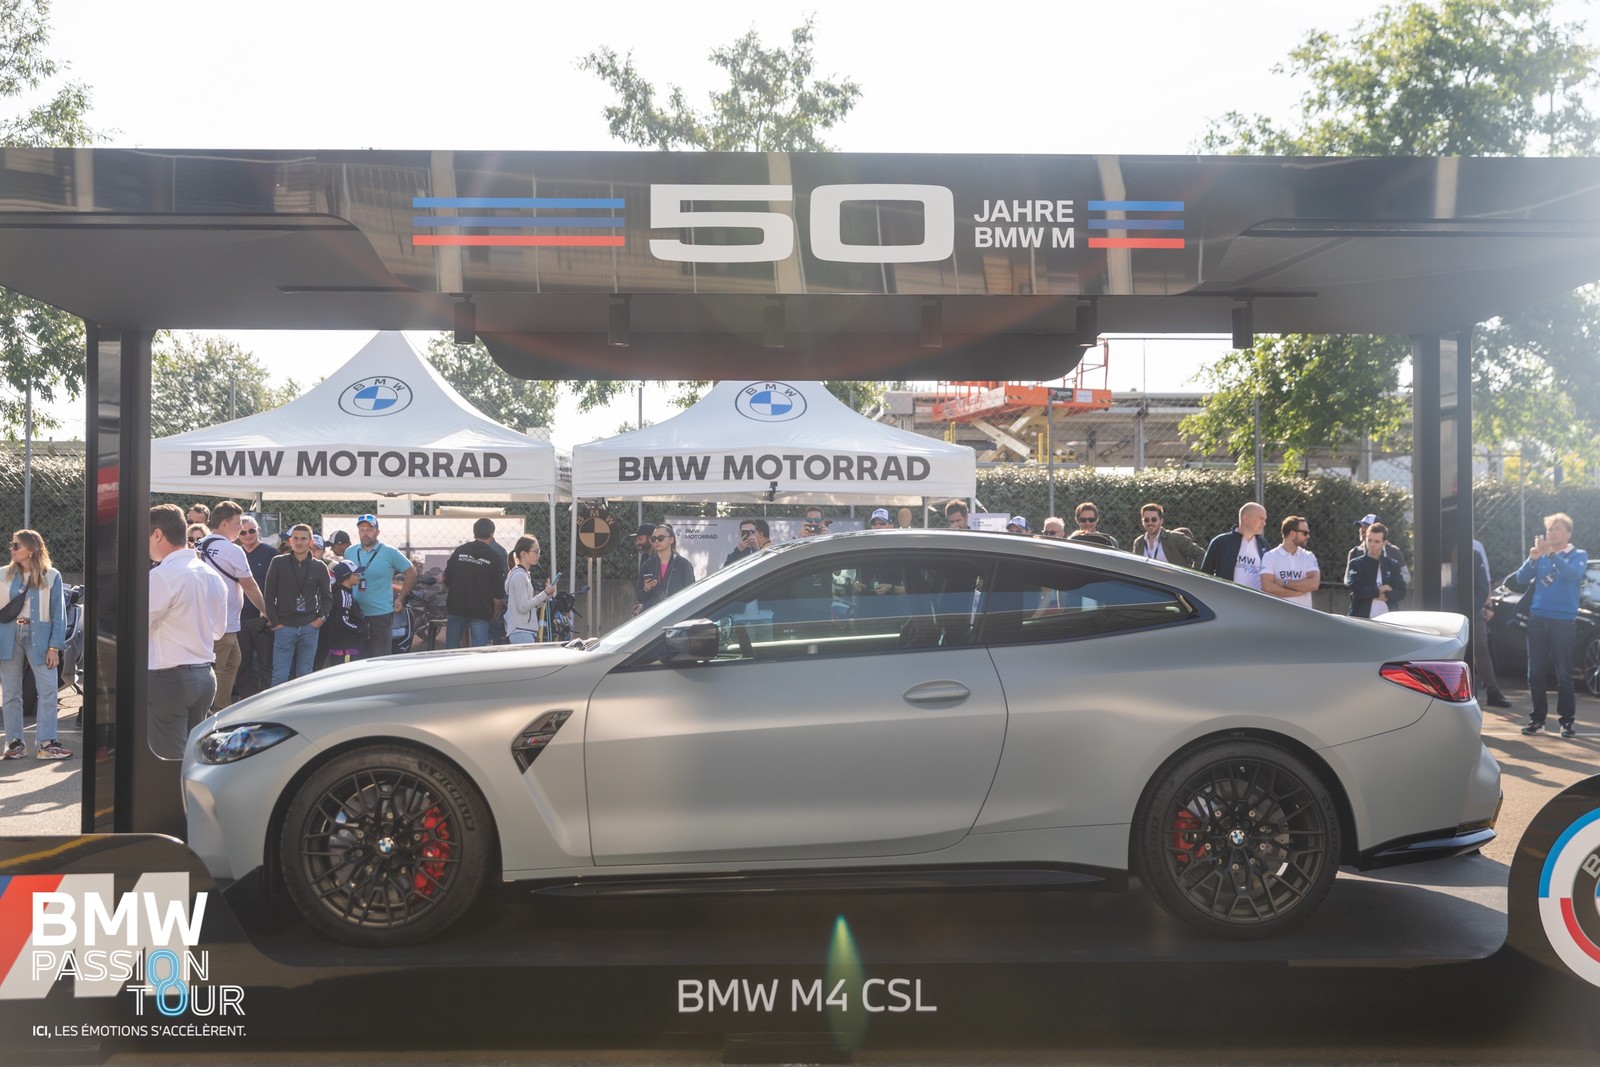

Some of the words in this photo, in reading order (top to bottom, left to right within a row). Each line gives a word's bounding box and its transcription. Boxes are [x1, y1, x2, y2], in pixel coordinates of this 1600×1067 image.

[973, 199, 1075, 223] JAHRE
[649, 183, 955, 263] 50
[974, 226, 1045, 249] BMW
[1051, 227, 1075, 249] M
[353, 378, 405, 392] BMW
[745, 383, 797, 397] BMW
[190, 450, 284, 476] BMW
[296, 450, 508, 477] MOTORRAD
[618, 456, 711, 481] BMW
[723, 454, 931, 481] MOTORRAD
[1238, 555, 1256, 565] MW
[1280, 570, 1303, 579] BMW
[678, 979, 779, 1013] BMW
[791, 979, 848, 1012] M4
[862, 978, 938, 1012] CSL
